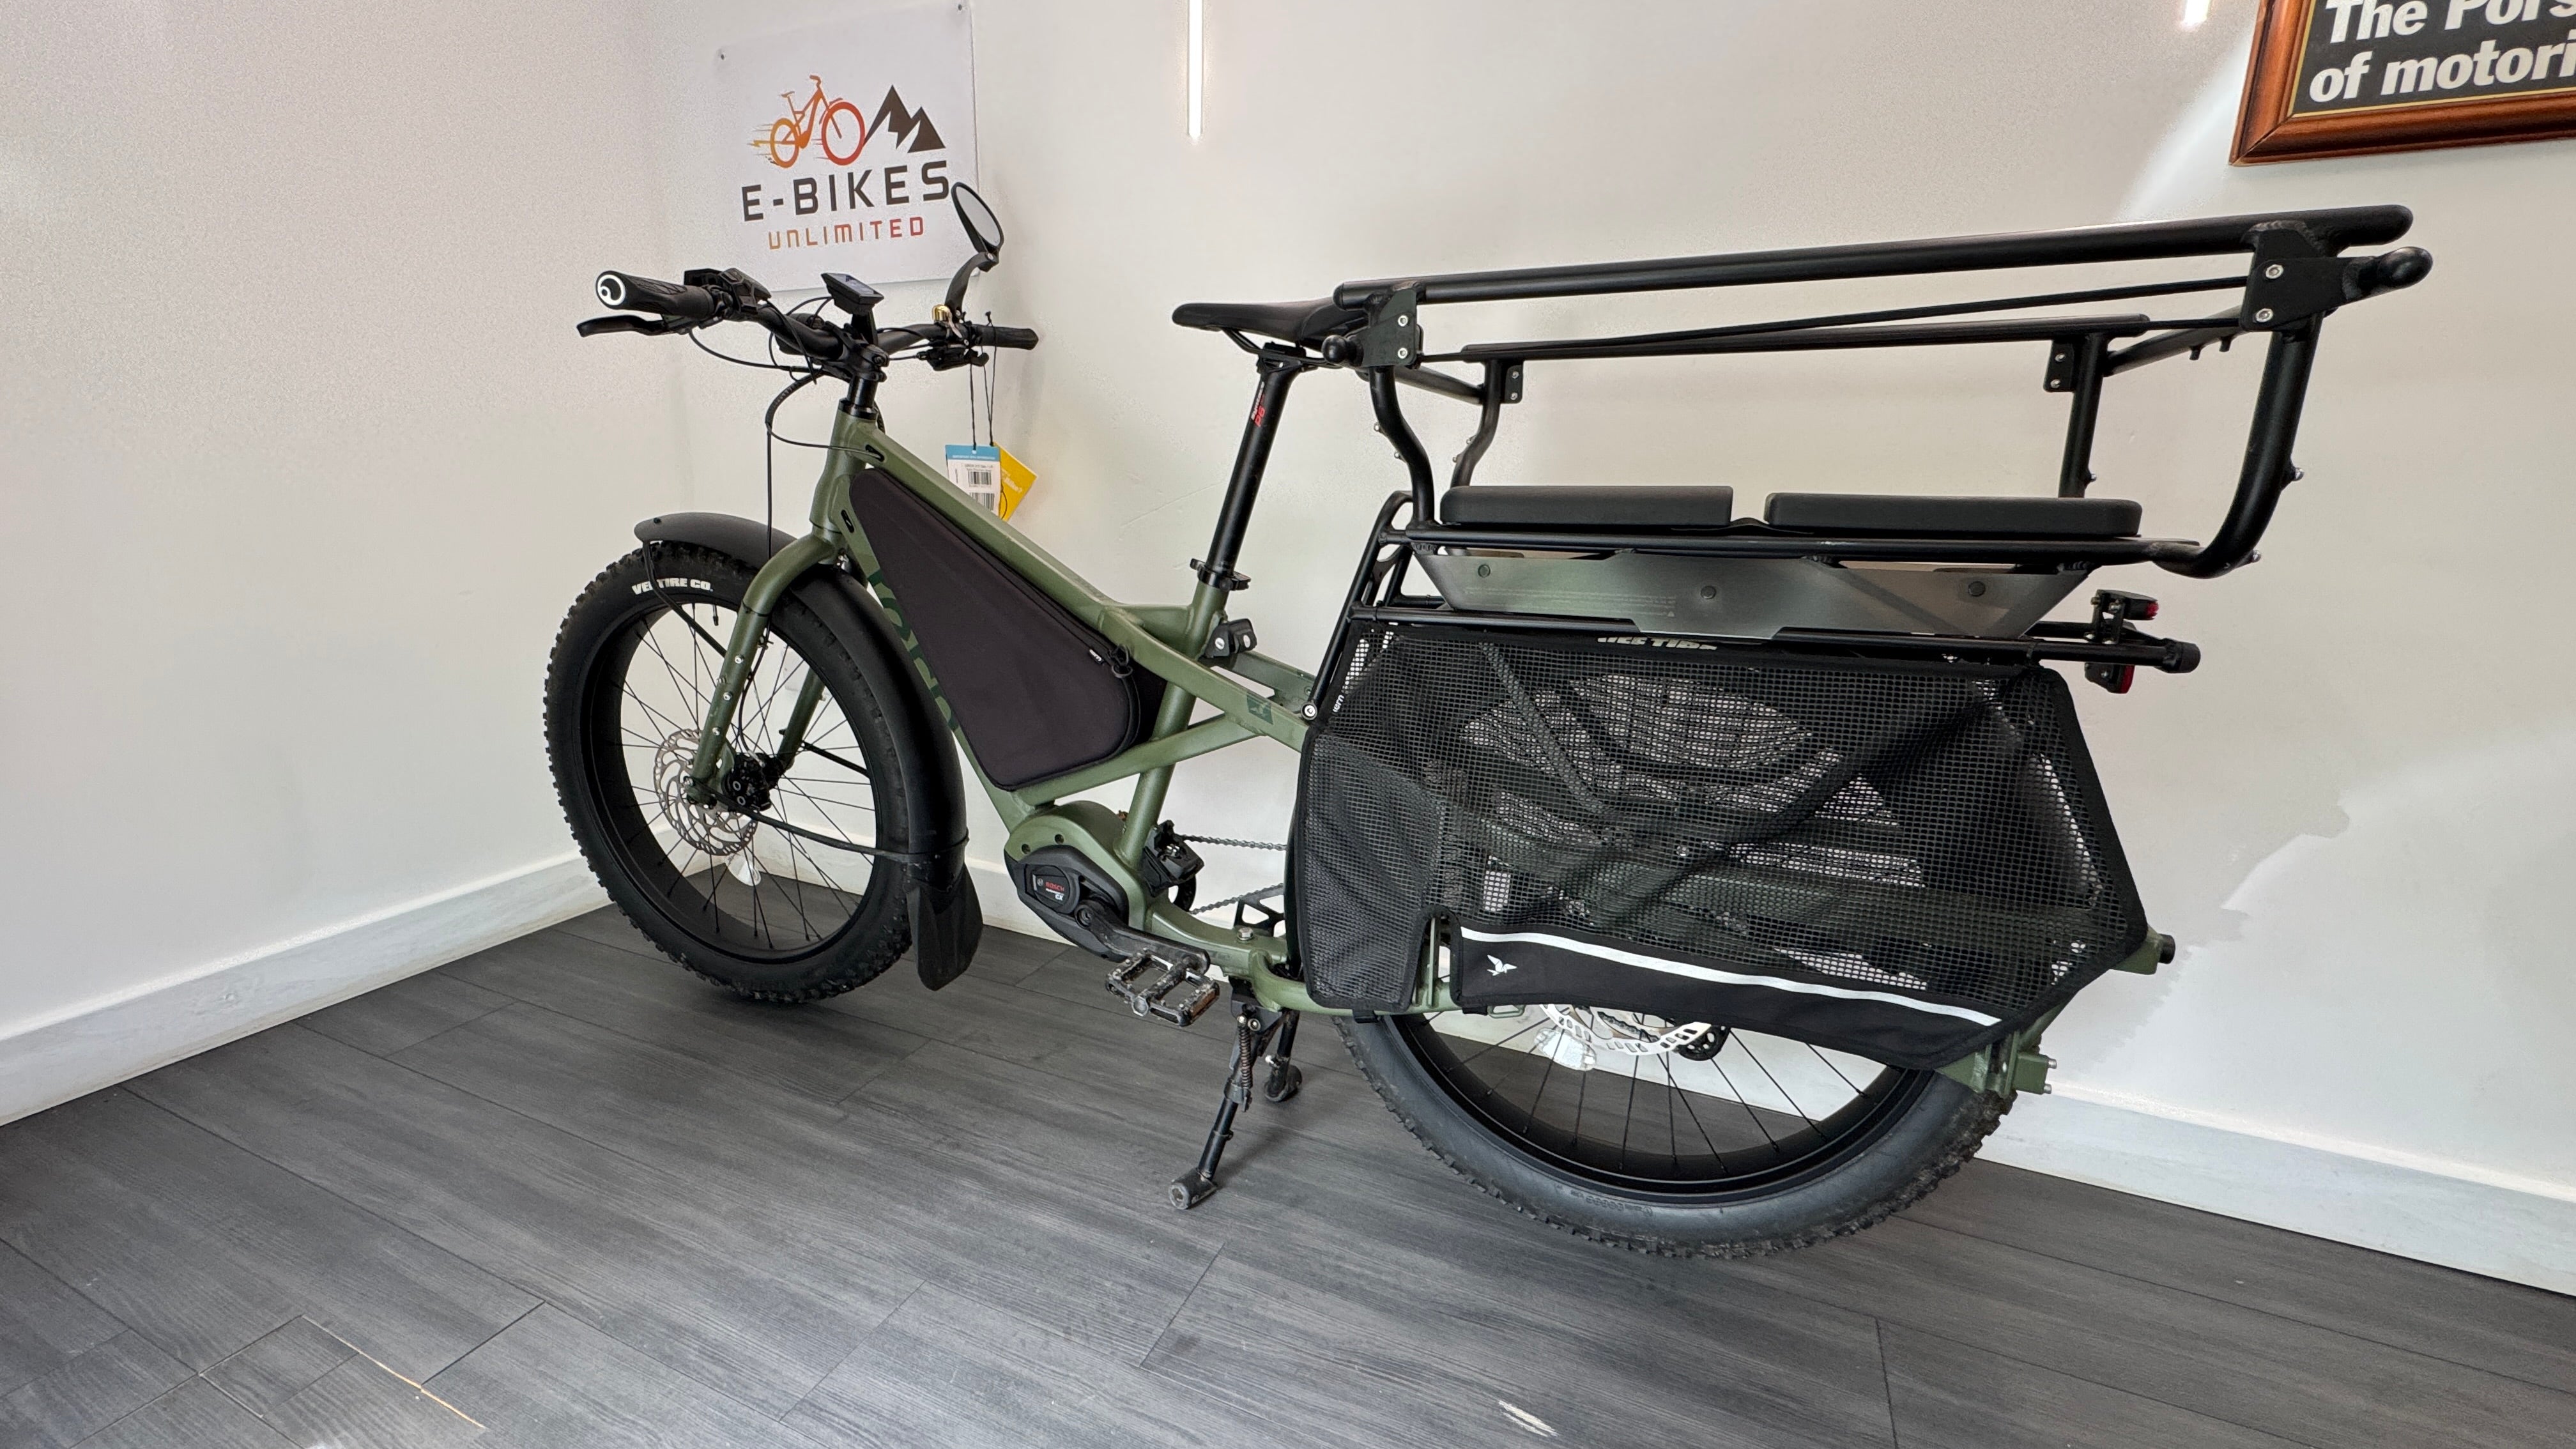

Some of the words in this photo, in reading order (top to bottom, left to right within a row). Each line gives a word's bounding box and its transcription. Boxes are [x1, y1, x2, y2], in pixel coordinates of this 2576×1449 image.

[2326, 0, 2427, 43] The
[2310, 50, 2373, 103] of
[2380, 29, 2576, 95] motori
[742, 160, 949, 221] E-BIKES
[769, 217, 923, 250] UNLIMITED
[656, 578, 688, 588] TIRE
[1045, 881, 1065, 892] BOSCH
